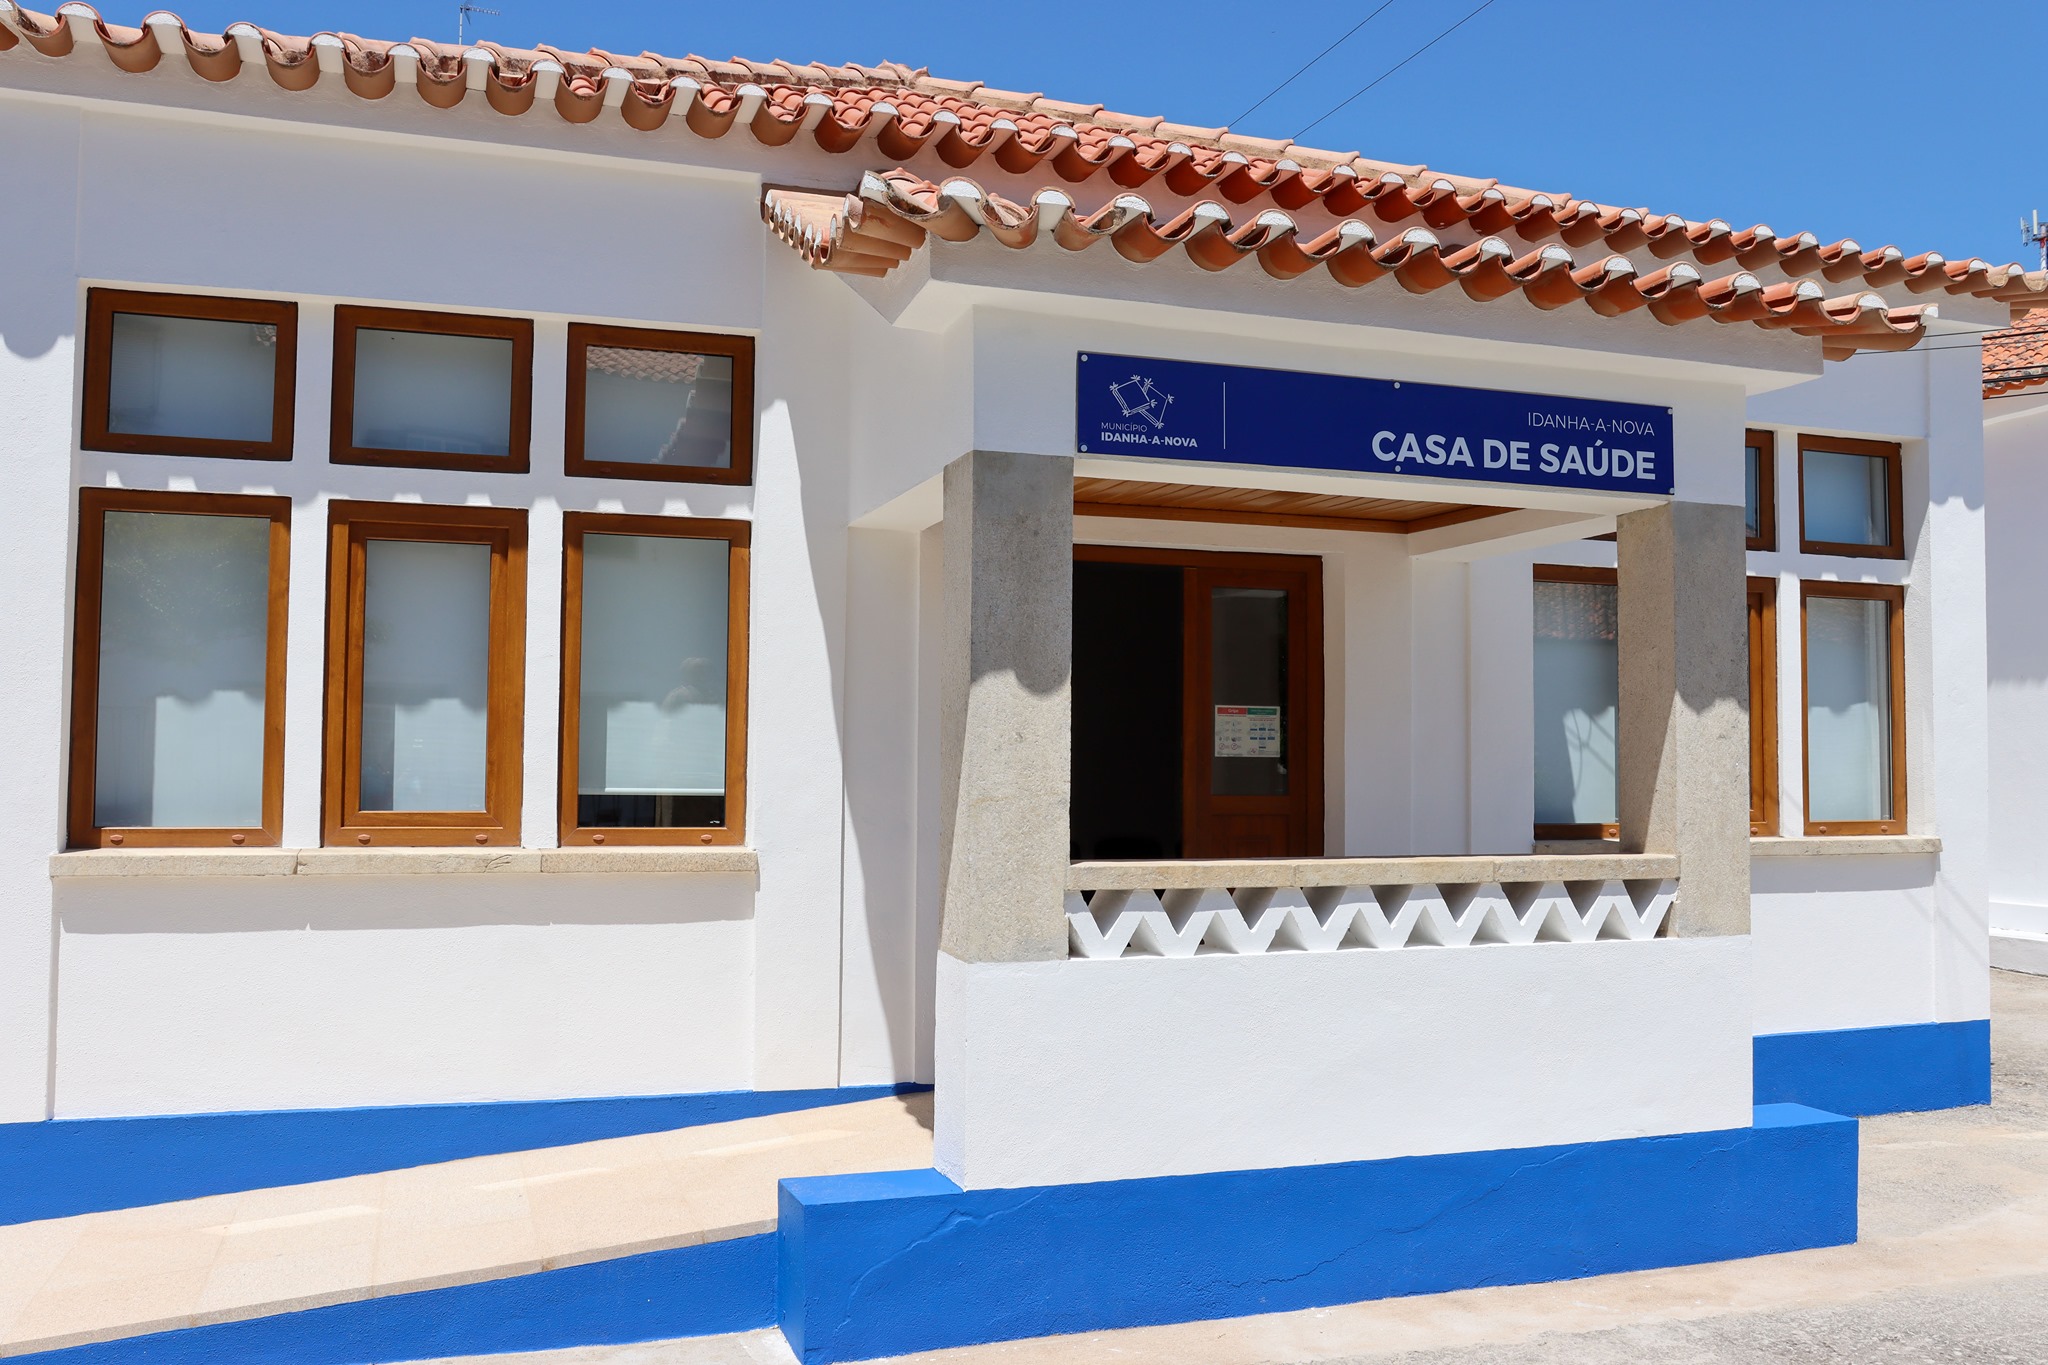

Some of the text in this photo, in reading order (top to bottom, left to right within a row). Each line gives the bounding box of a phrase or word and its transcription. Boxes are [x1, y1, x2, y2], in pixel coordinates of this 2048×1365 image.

[1101, 422, 1148, 432] MUNICÍPIO
[1528, 412, 1655, 437] IDANHA-A-NOVA
[1101, 431, 1198, 448] IDANHA-A-NOVA
[1372, 430, 1656, 481] CASA DE SAÚDE
